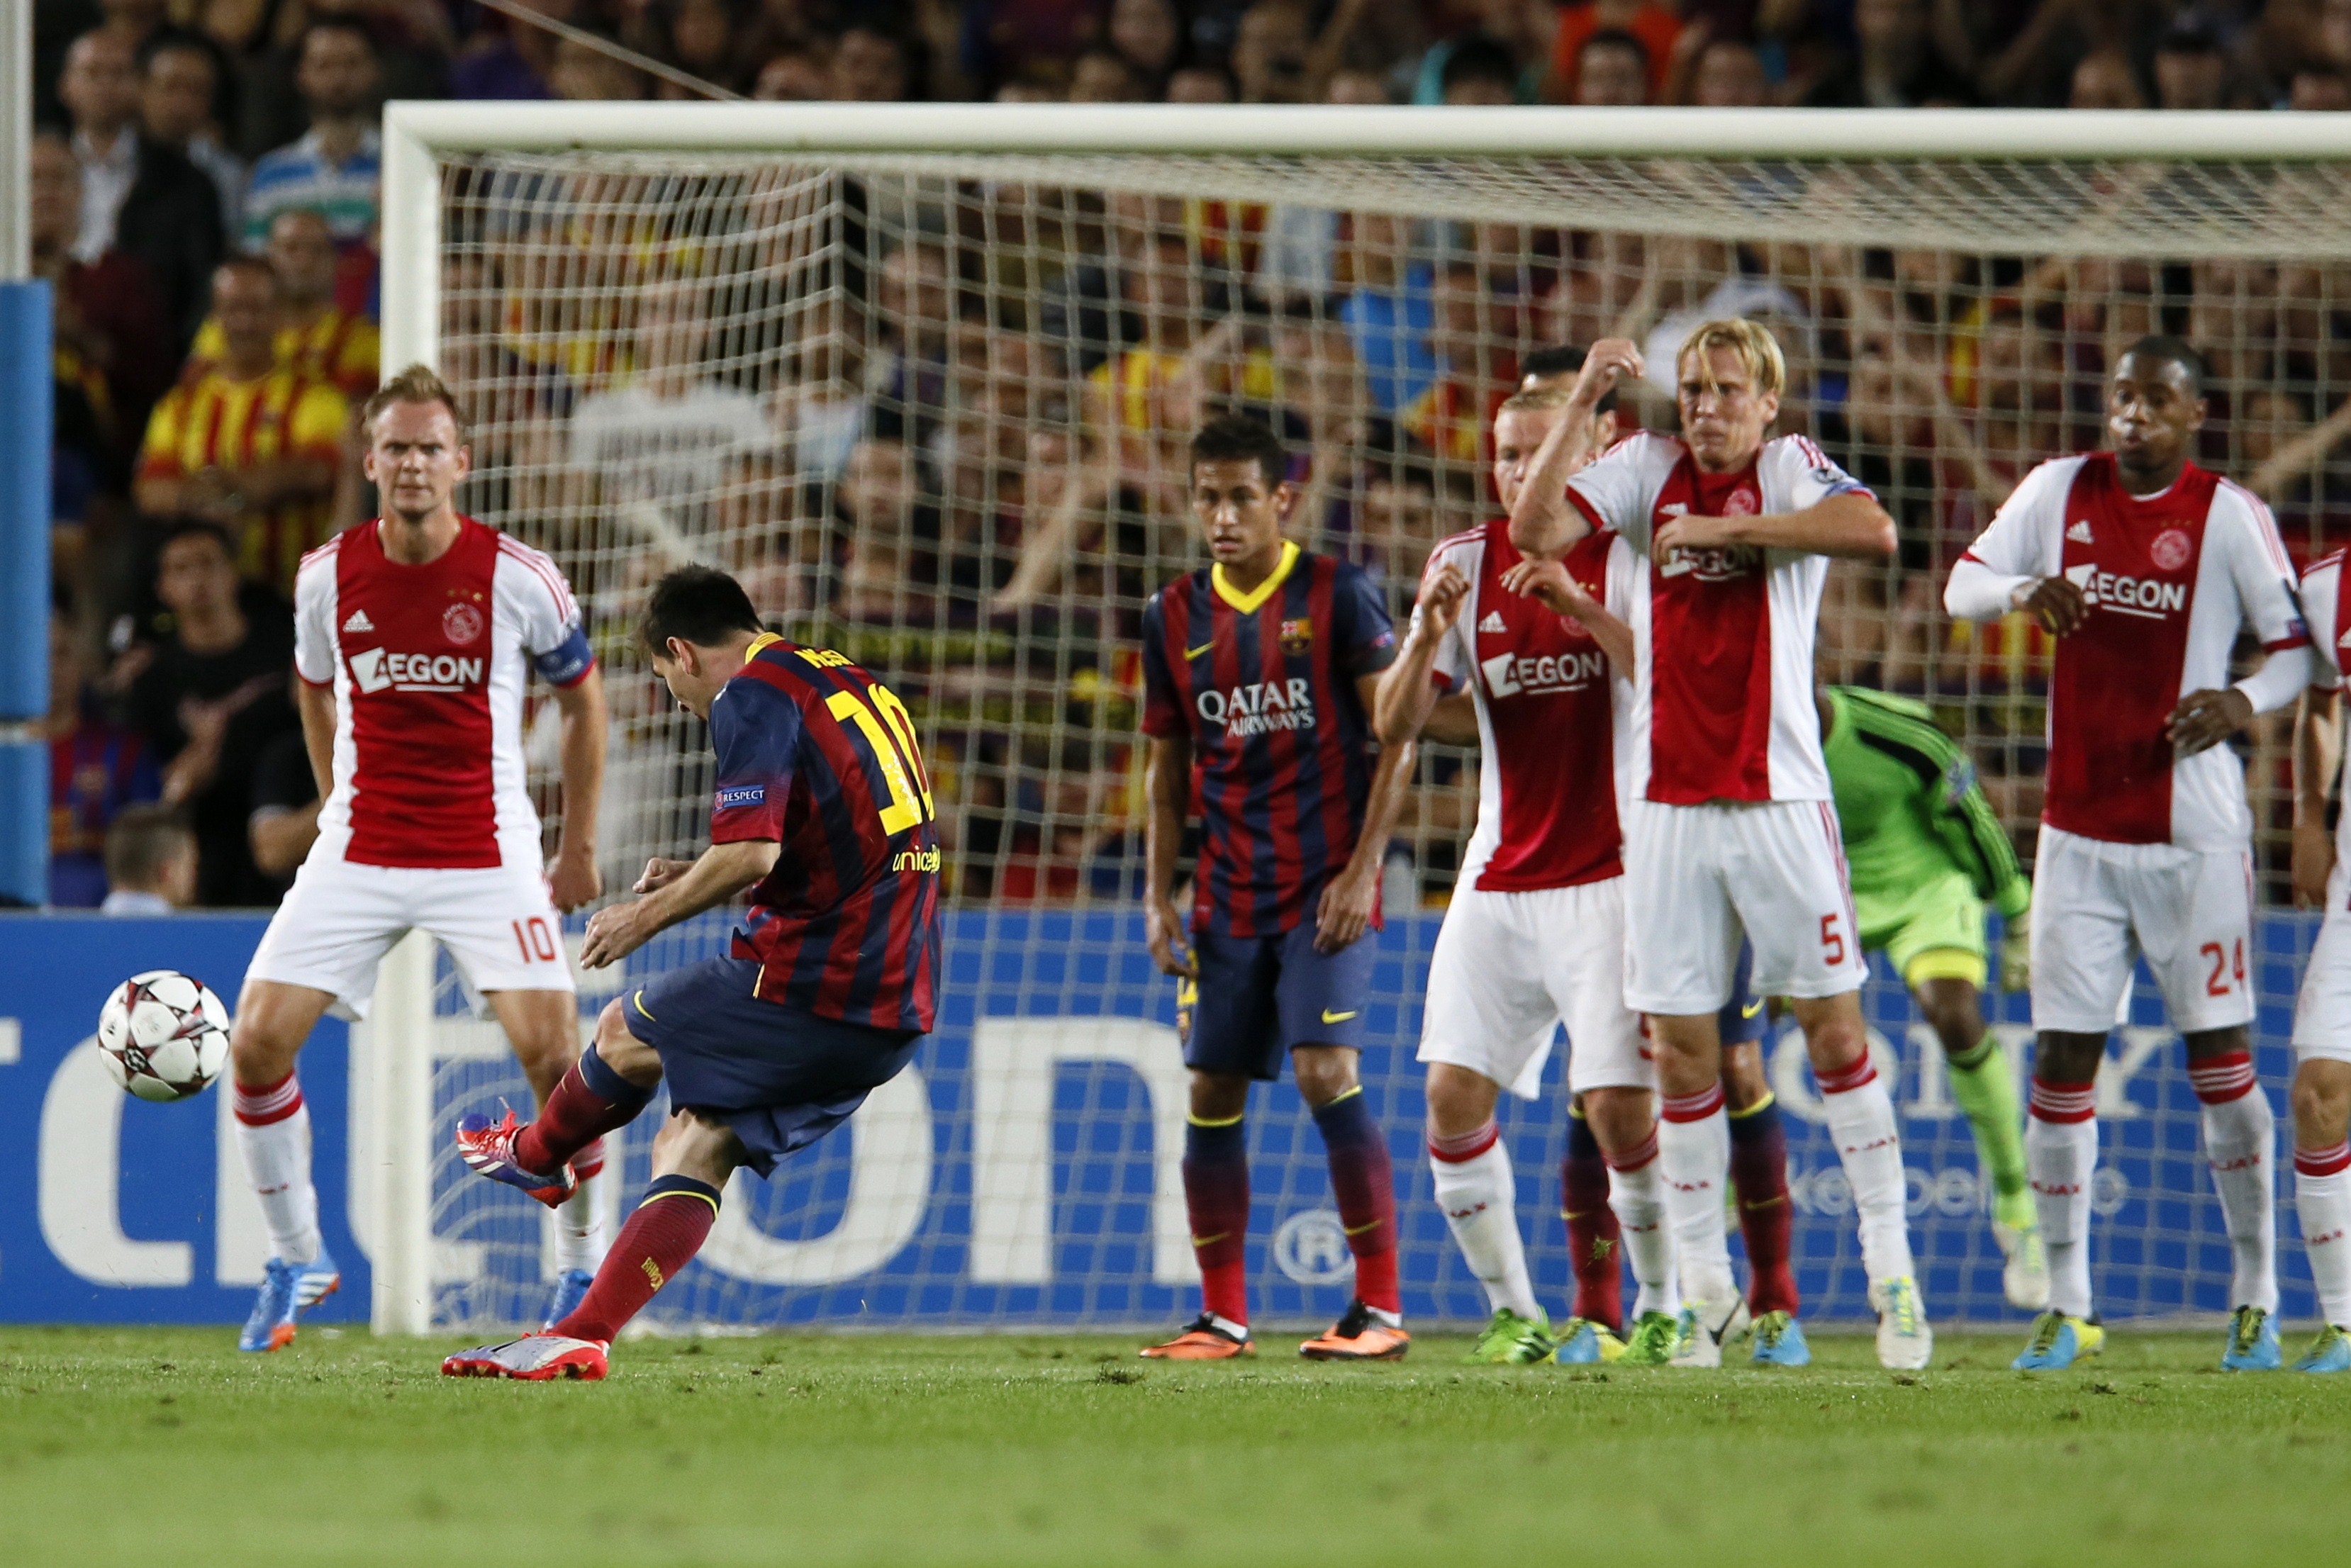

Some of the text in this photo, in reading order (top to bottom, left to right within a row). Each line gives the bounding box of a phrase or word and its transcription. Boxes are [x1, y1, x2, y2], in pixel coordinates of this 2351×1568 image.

[357, 648, 484, 690] AEGON
[1492, 651, 1604, 693] AEGON
[1197, 678, 1312, 725] QATAR
[1227, 708, 1316, 737] AIRWAYS
[825, 683, 934, 836] 10
[723, 790, 764, 802] RESPECT
[513, 917, 555, 963] 10
[1821, 914, 1844, 965] 5
[2199, 937, 2245, 997] 24
